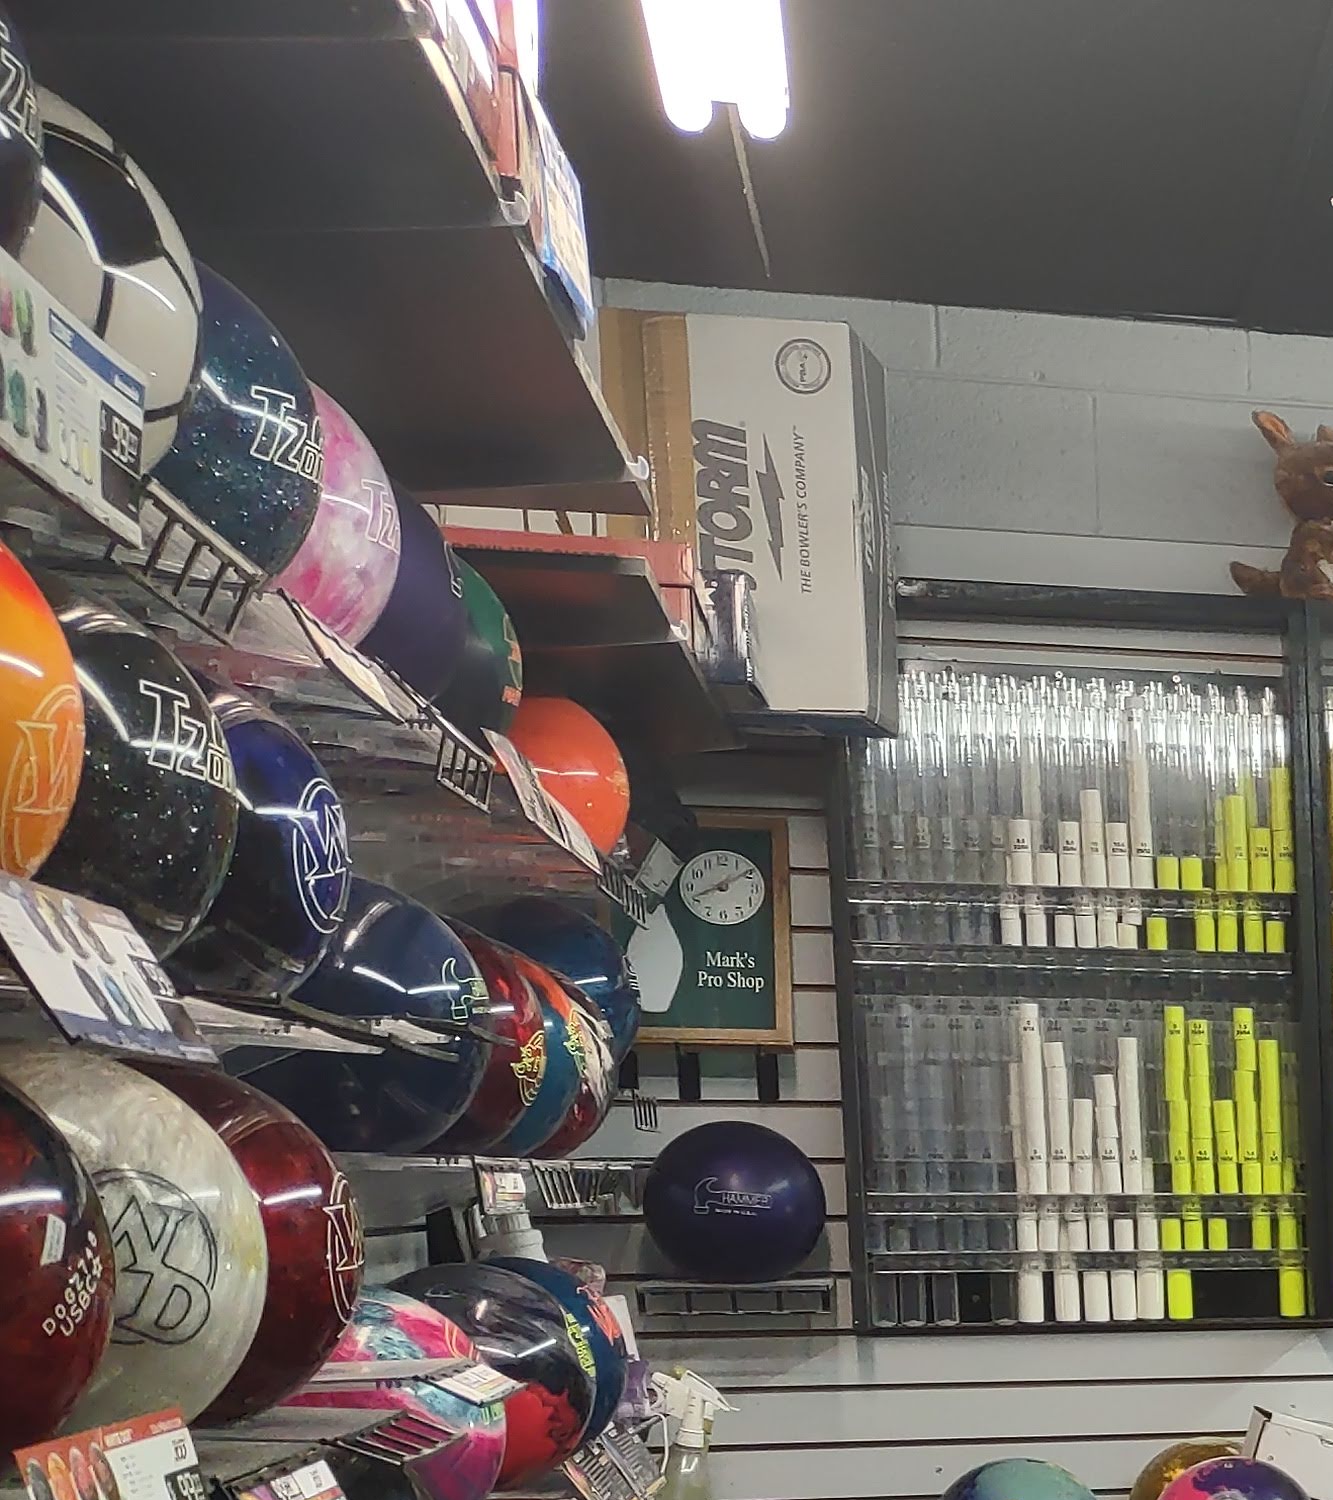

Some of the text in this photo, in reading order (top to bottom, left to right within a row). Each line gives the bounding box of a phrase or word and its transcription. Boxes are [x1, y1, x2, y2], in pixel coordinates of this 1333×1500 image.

[692, 418, 757, 590] TORM
[795, 433, 812, 595] THE BOWLER'S COMPANY
[697, 971, 765, 993] Pro Shop
[706, 951, 756, 969] Mark's
